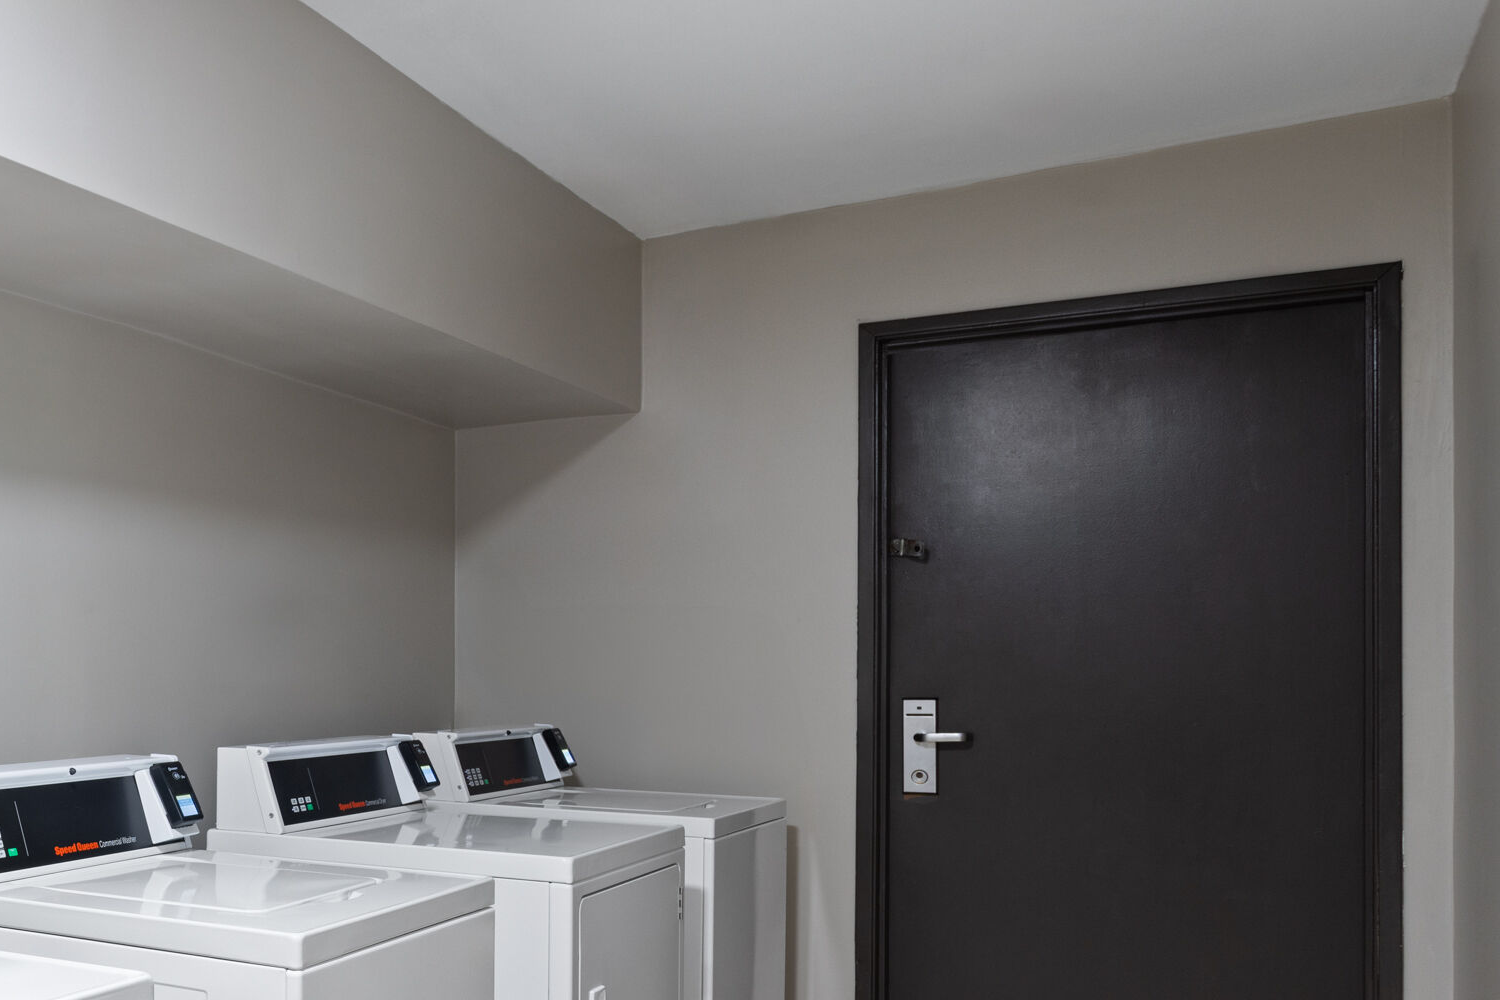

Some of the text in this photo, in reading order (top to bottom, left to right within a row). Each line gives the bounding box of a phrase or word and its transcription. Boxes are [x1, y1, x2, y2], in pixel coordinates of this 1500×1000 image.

[54, 843, 77, 856] Speed
[76, 841, 99, 851] Queen
[99, 838, 122, 848] Commercial
